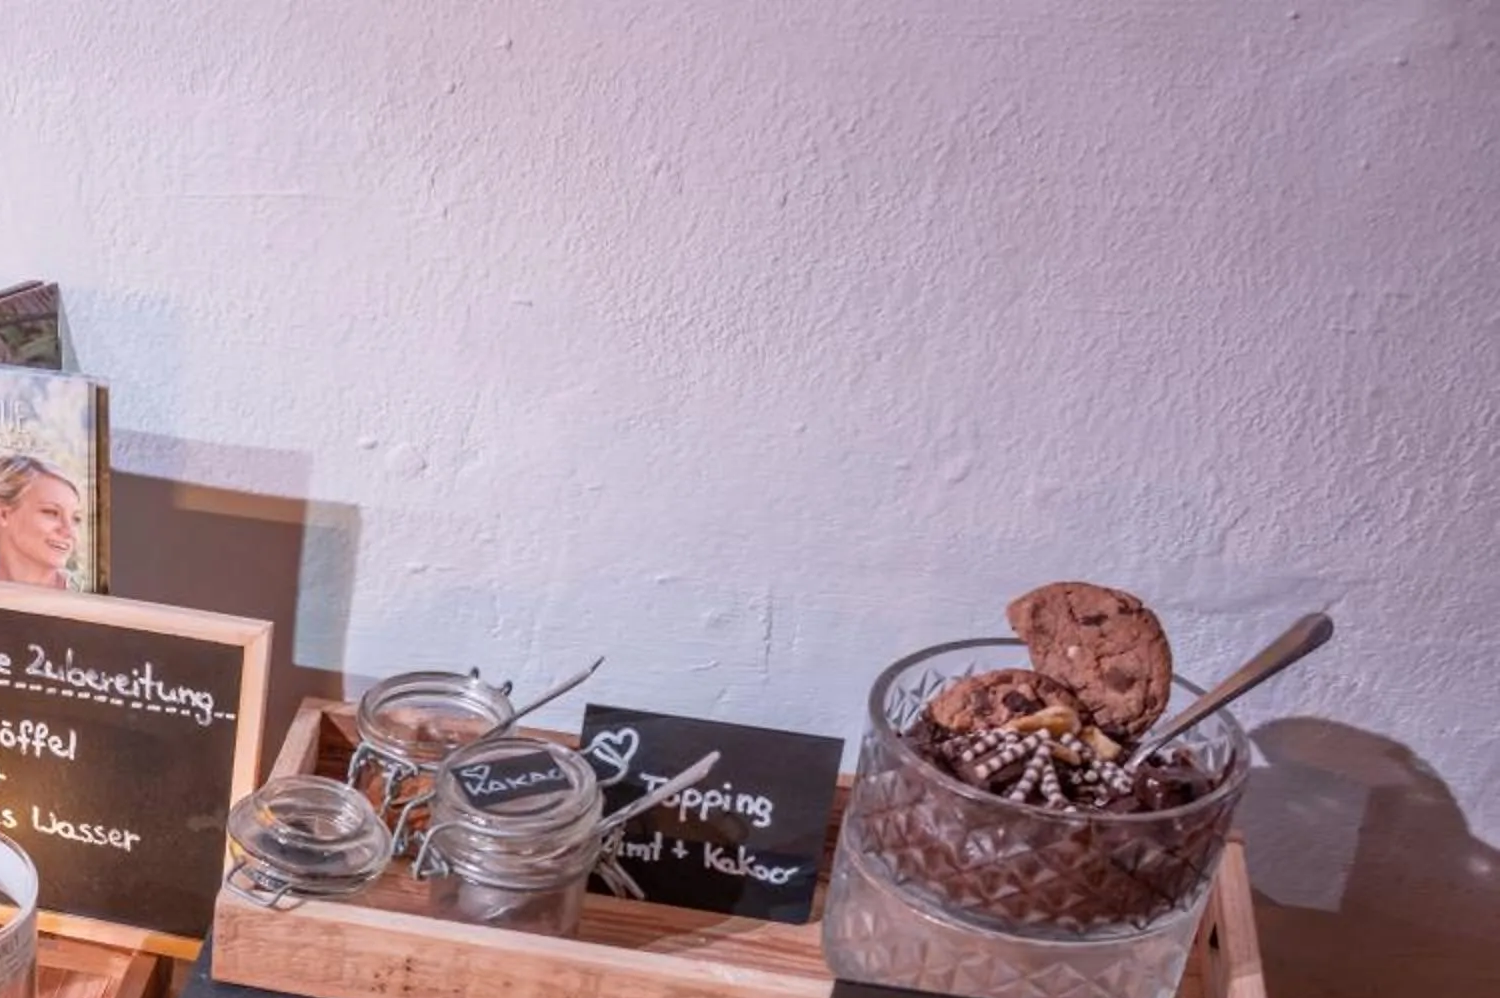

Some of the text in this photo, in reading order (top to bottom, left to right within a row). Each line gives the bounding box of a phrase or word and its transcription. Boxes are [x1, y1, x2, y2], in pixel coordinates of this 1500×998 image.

[25, 643, 216, 726] Zubereitung
[32, 805, 141, 852] Wasser
[671, 838, 690, 860] +
